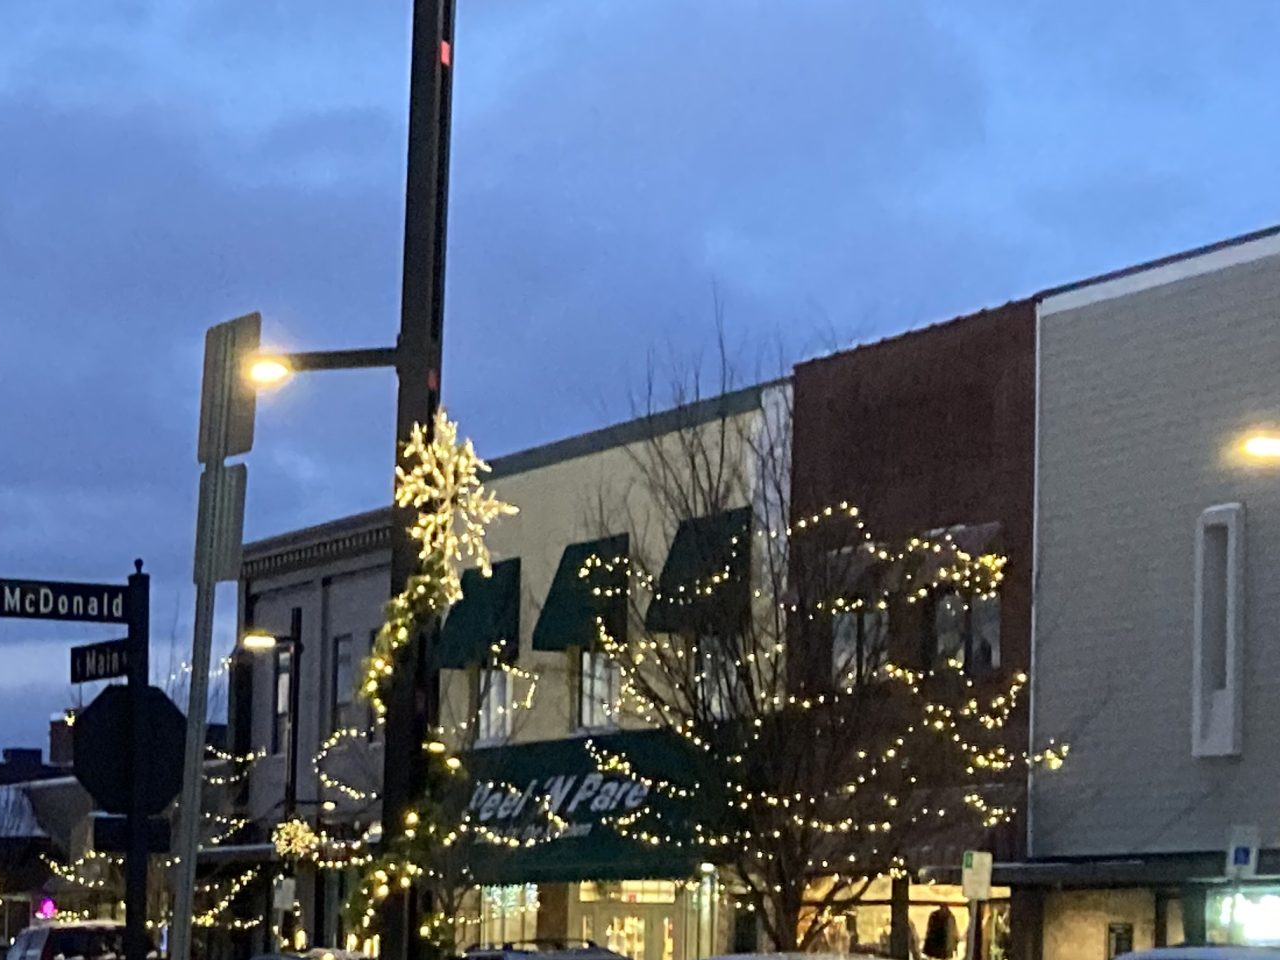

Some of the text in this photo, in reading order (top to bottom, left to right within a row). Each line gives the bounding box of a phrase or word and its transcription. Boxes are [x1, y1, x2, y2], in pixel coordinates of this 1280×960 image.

[4, 586, 123, 617] McDonald
[86, 649, 119, 677] Main
[566, 773, 648, 812] Pare
